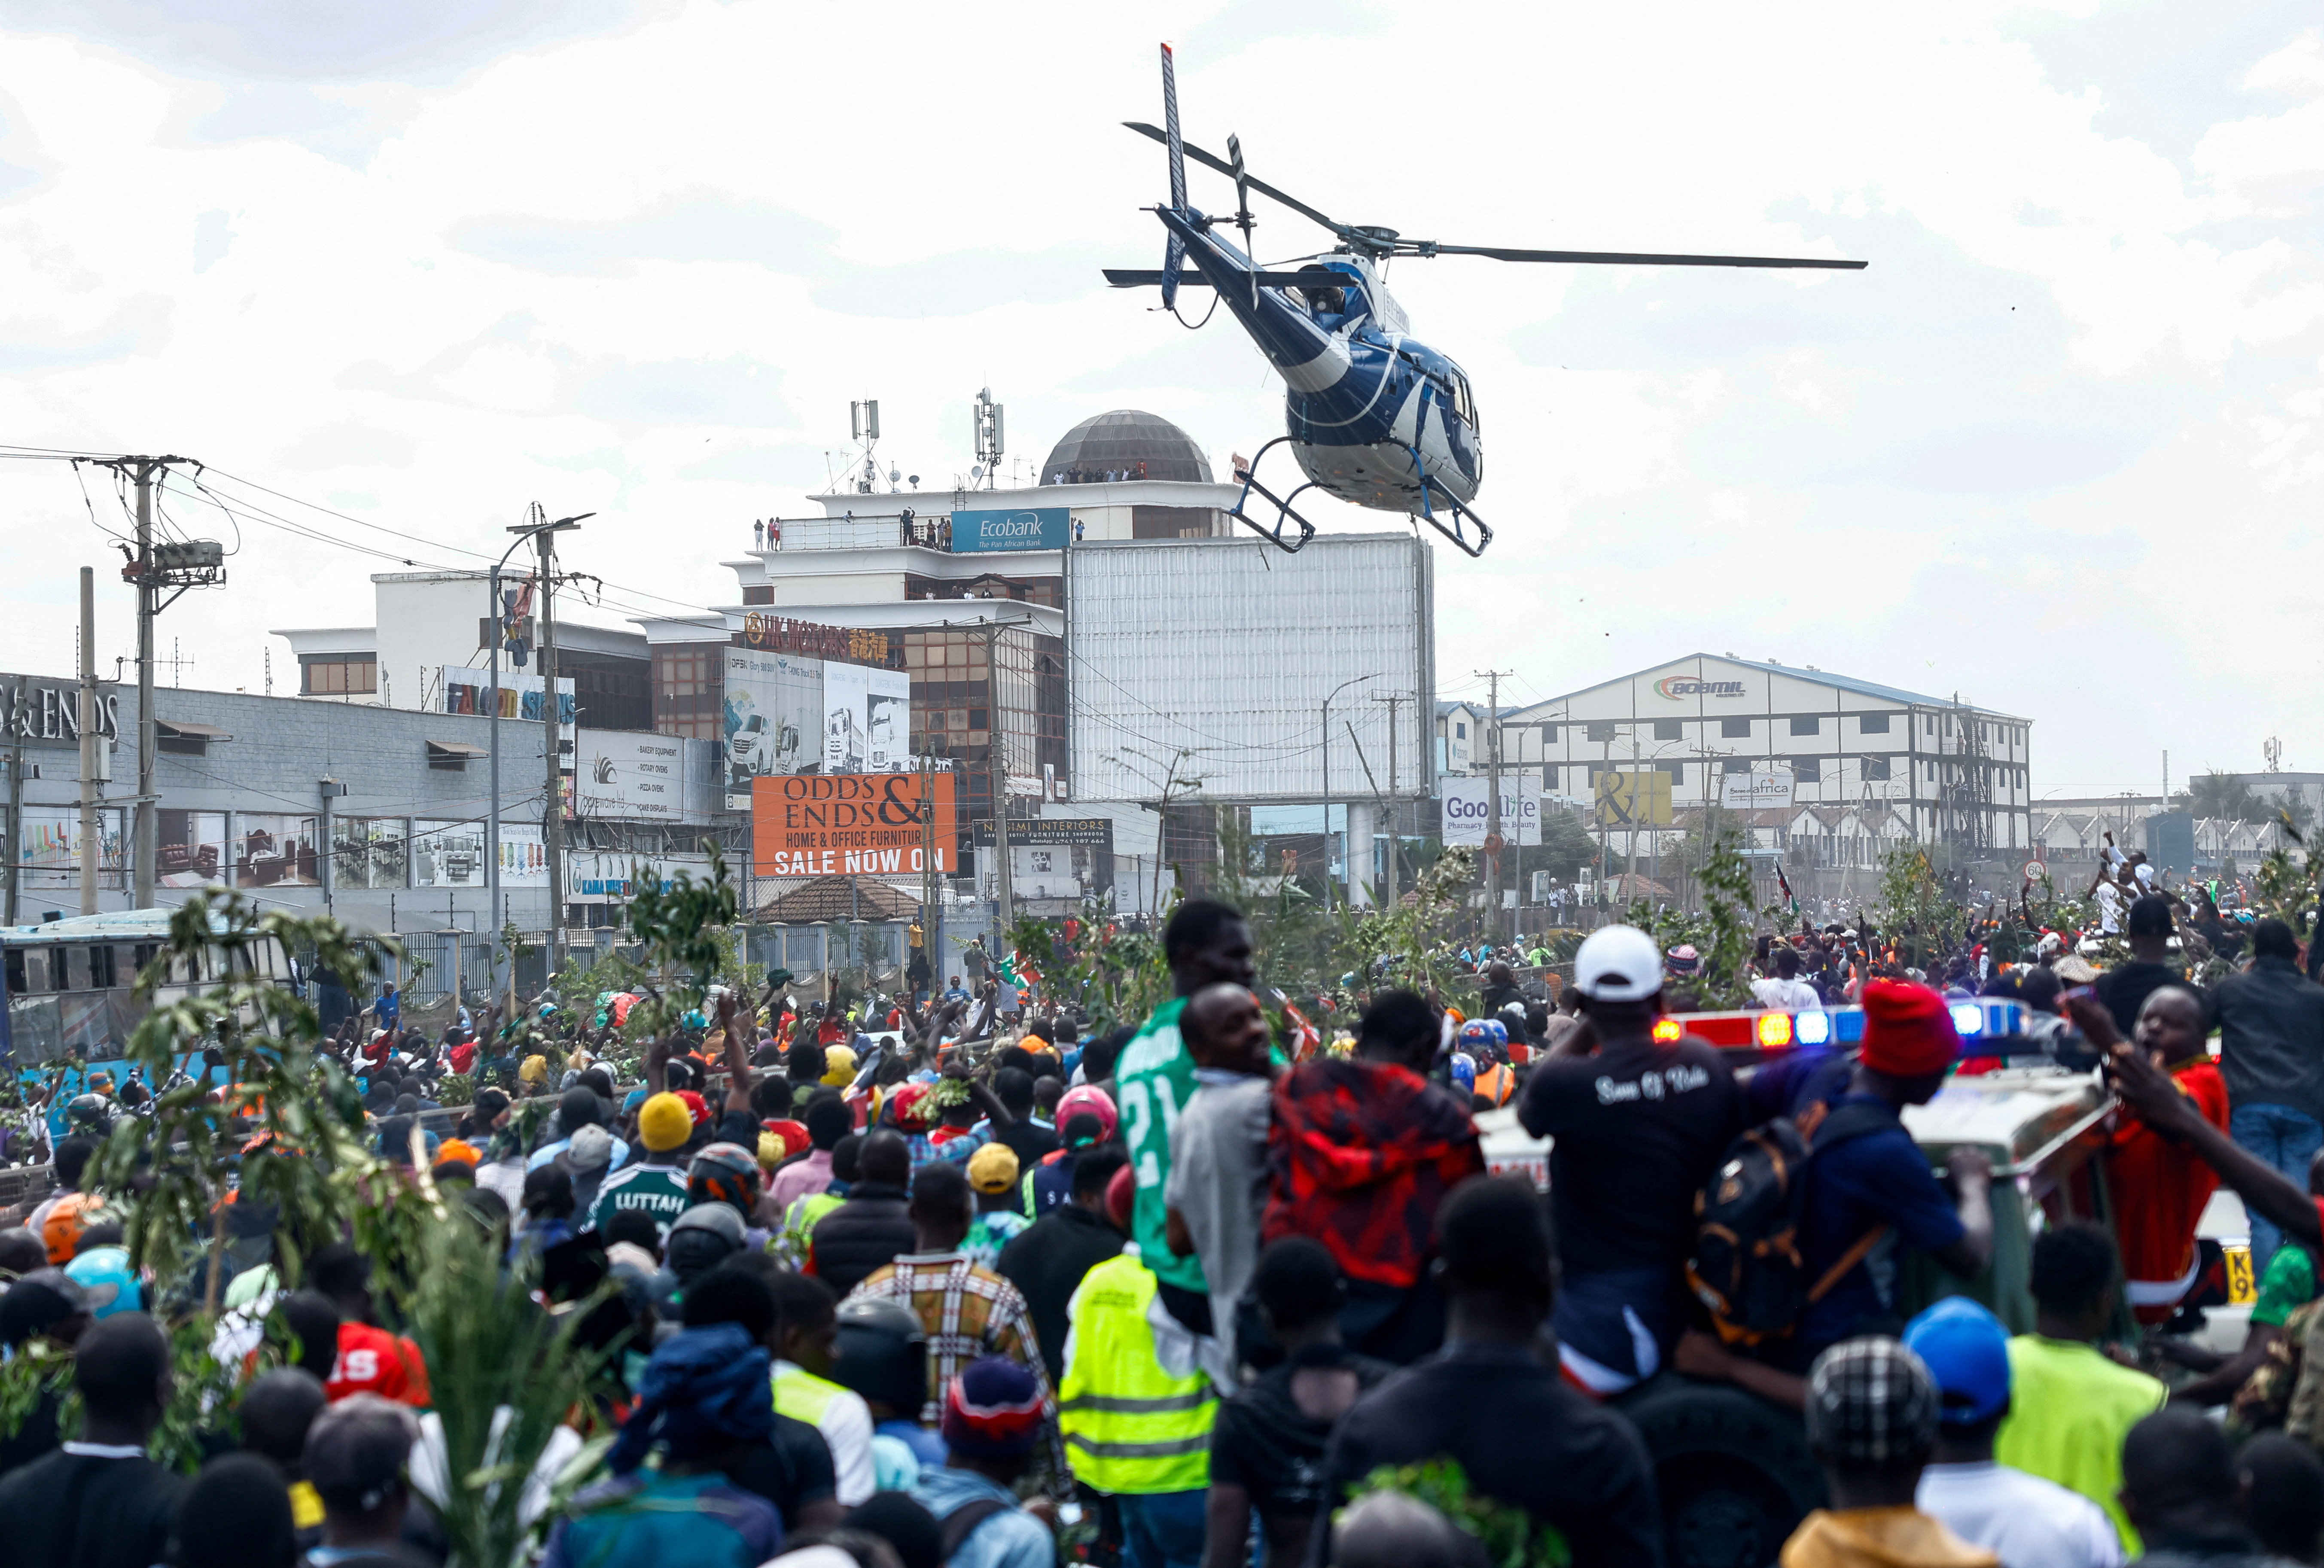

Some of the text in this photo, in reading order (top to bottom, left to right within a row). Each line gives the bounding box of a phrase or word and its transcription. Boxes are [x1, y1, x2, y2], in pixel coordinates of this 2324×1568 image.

[980, 512, 1043, 536] Ecobank
[765, 615, 847, 657] HK MOTORS
[731, 658, 747, 669] DFSK
[750, 661, 760, 673] Glory
[788, 667, 800, 676] T-KING
[801, 668, 810, 678] Truck
[1672, 681, 1746, 694] BOBMIL
[521, 690, 575, 724] SINS
[640, 746, 676, 756] BAKERY EQUIPMENT
[640, 764, 668, 773] ROTARY OVENS
[640, 783, 651, 792] PIZZA
[1753, 779, 1788, 793] africa
[650, 804, 667, 813] DISPLAYS
[784, 776, 923, 826] ODDS &
[784, 802, 874, 828] ENDS
[984, 821, 1104, 832] NIMI INTERIORS
[787, 830, 922, 848] HOME & OFFICE FURNITUR
[775, 847, 943, 875] SALE NOW ON
[2028, 865, 2041, 876] 60
[582, 880, 605, 895] KAMA
[615, 1192, 685, 1215] LUTTAH
